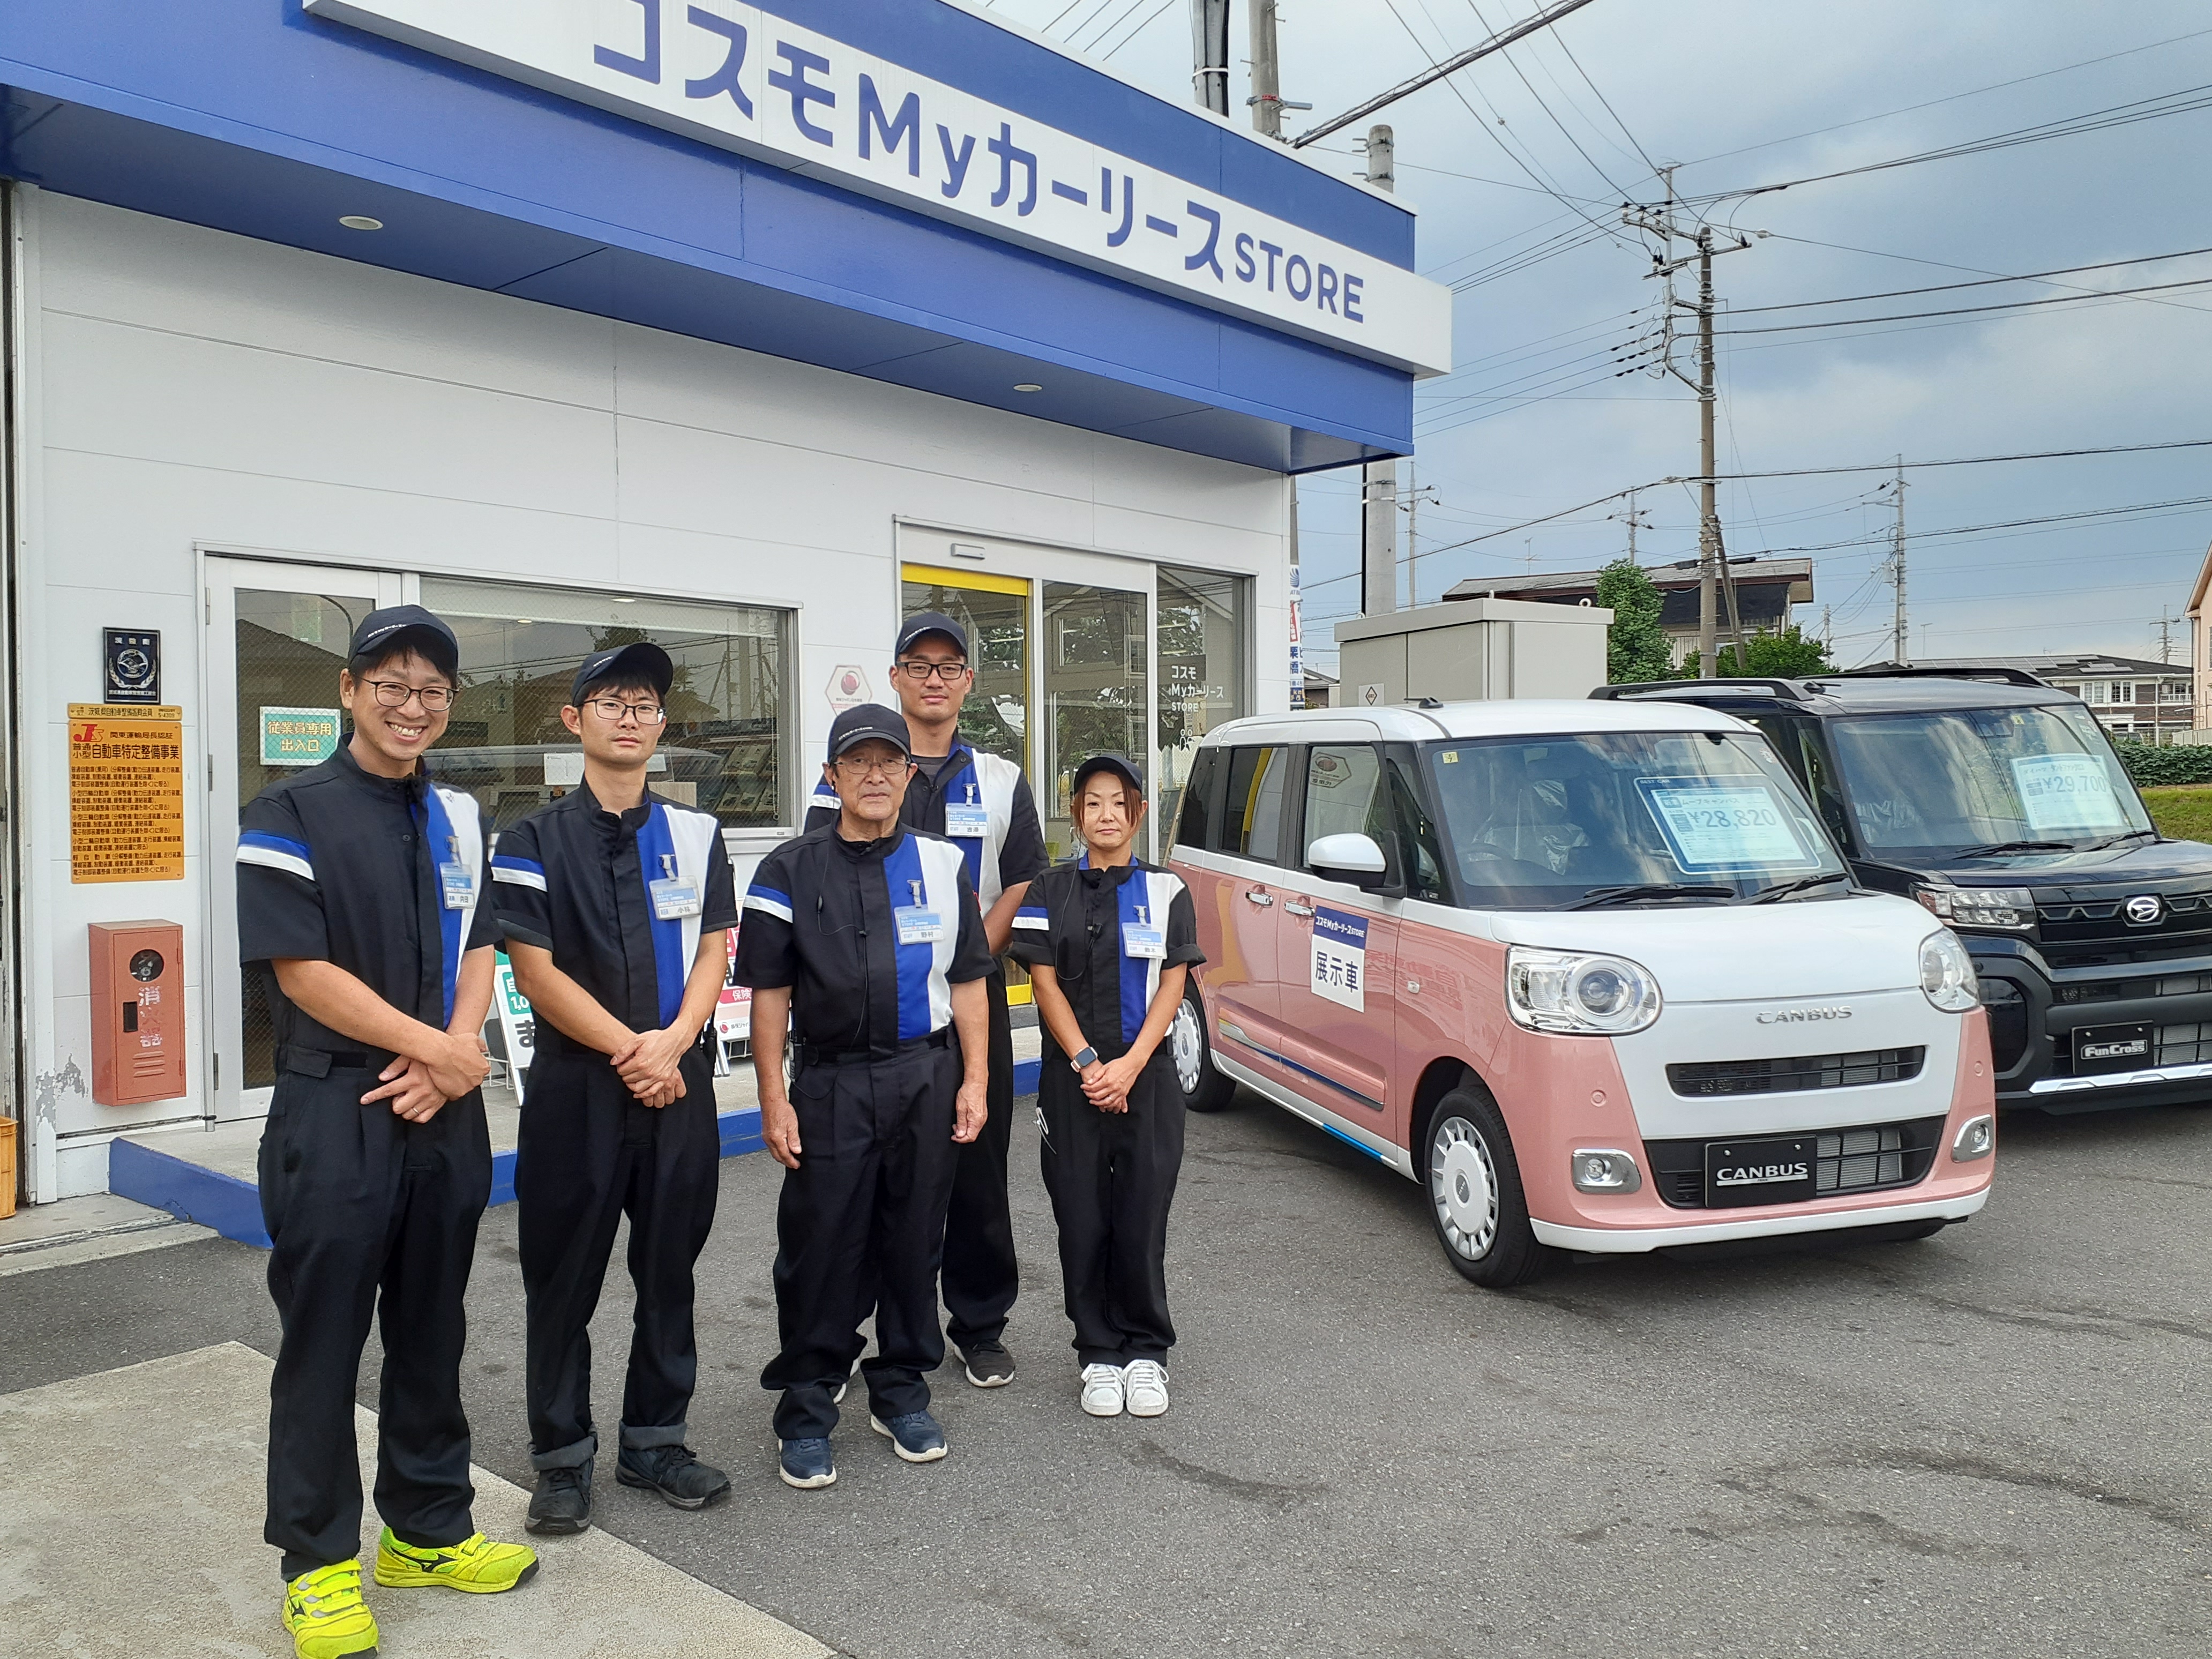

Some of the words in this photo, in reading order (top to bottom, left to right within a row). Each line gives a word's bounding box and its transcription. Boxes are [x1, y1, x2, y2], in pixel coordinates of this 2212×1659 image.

[1171, 666, 1196, 679] コスモ
[1171, 683, 1224, 698] Myカーリース
[1171, 702, 1199, 712] STORE
[268, 721, 332, 735] 従業員専用
[281, 739, 320, 751] 出入口
[2042, 775, 2107, 794] ¥29,700
[1687, 809, 1776, 829] ¥28,820
[1315, 951, 1358, 993] 展示車
[1756, 1005, 1852, 1024] CANBUS
[1716, 1162, 1809, 1180] CANBUS
